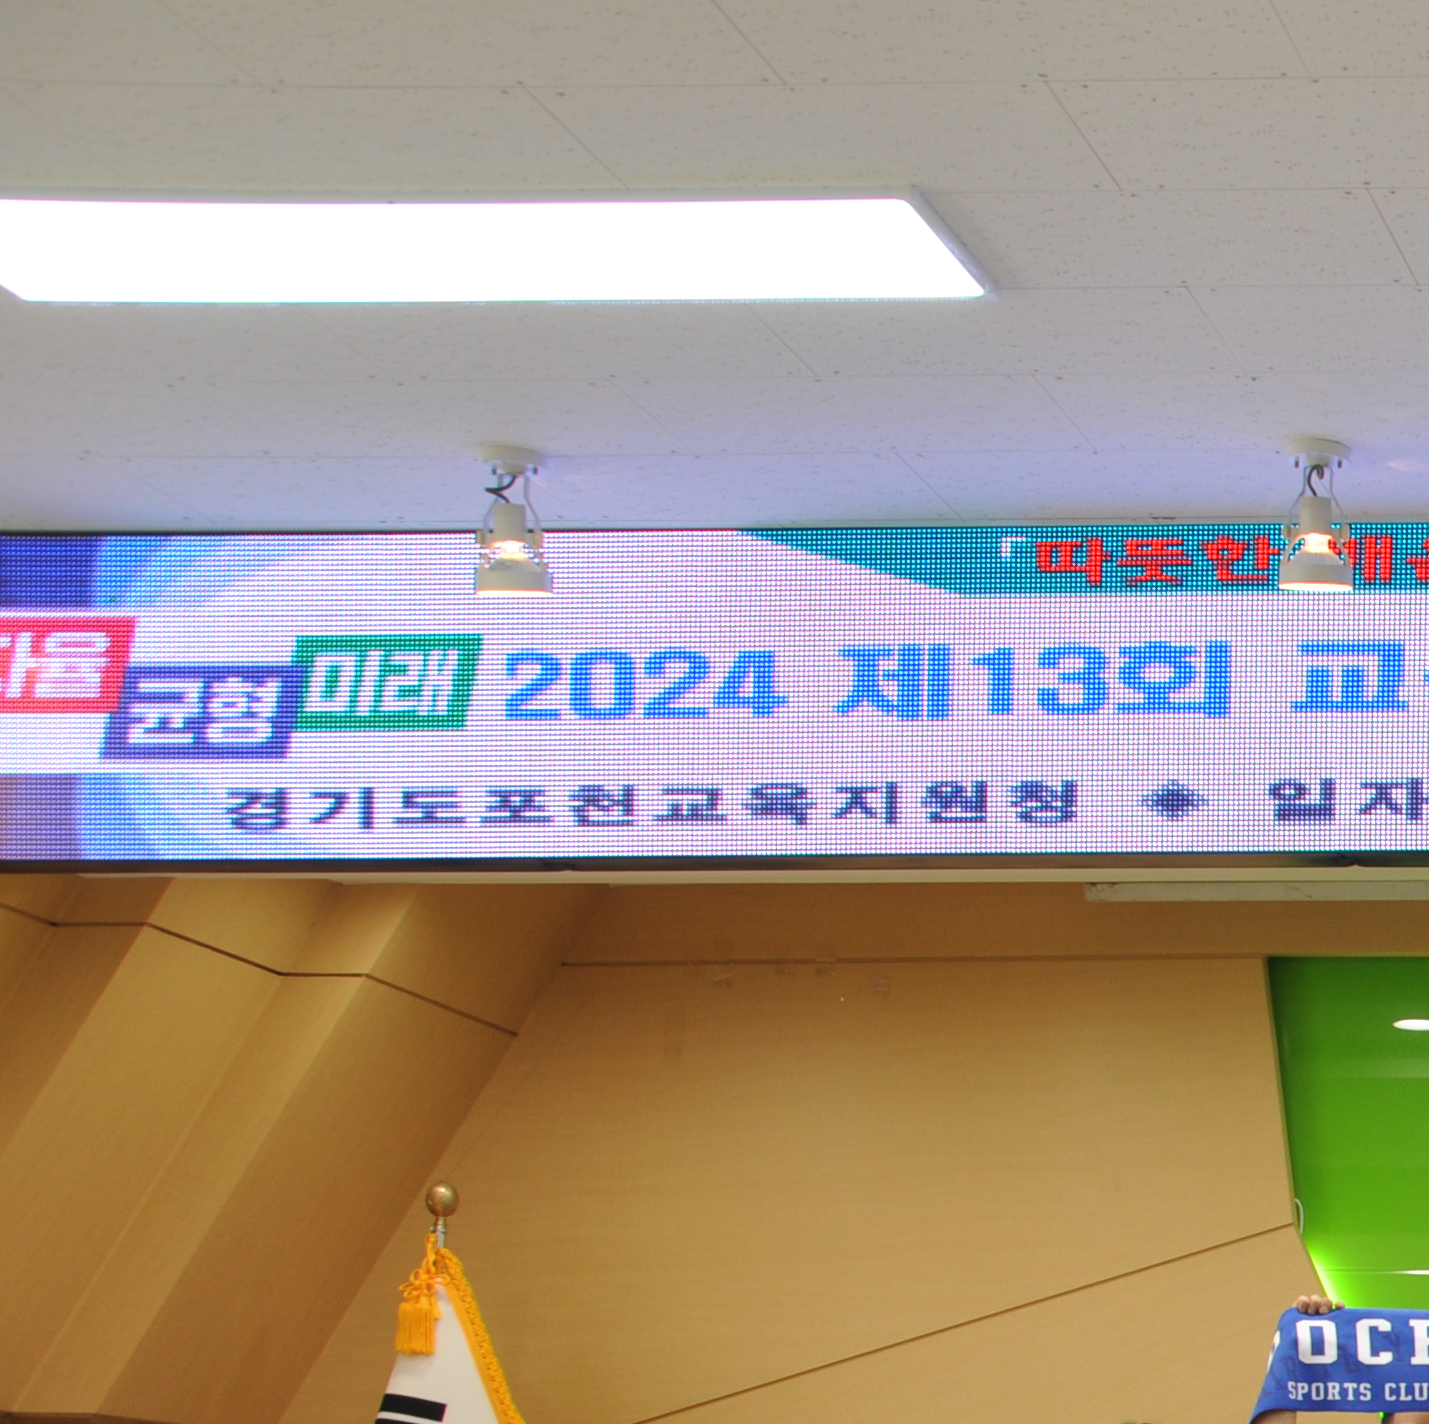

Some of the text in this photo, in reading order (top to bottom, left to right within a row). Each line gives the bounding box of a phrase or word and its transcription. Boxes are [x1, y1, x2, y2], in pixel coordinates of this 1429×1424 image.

[126, 675, 284, 745] 균형
[302, 648, 461, 717] 미래
[502, 649, 788, 721] 2024
[836, 638, 1232, 718] 제13회
[224, 777, 1079, 832] 경기도포천교육지원청
[1287, 1380, 1372, 1401] SPORTS
